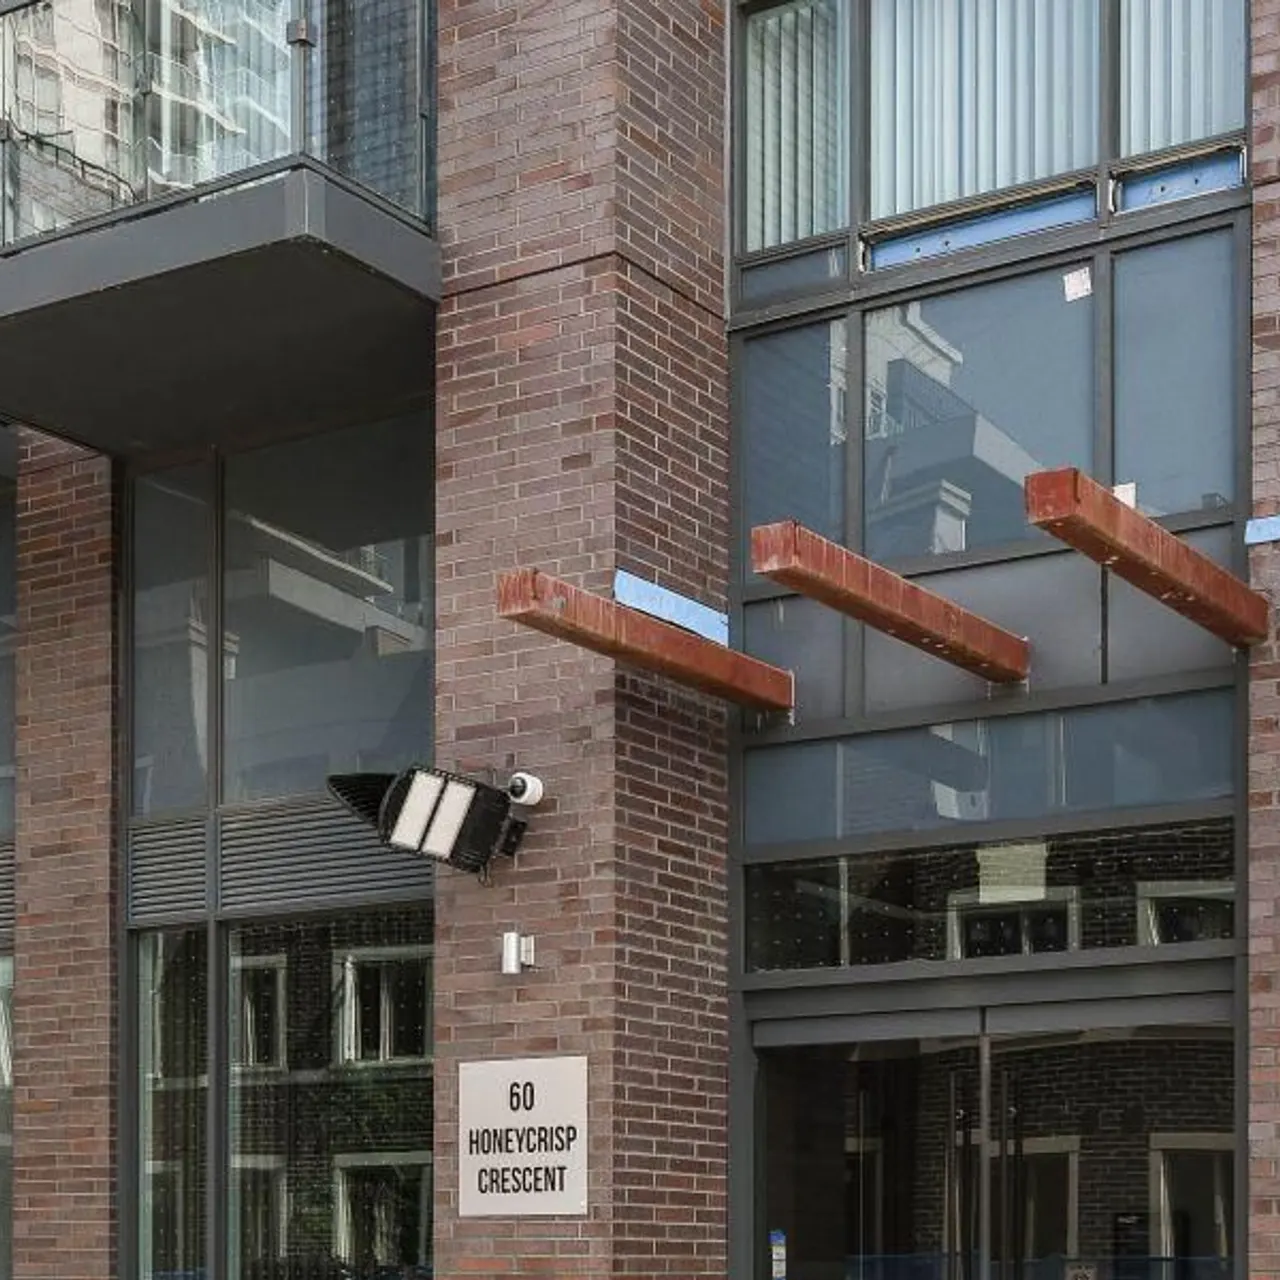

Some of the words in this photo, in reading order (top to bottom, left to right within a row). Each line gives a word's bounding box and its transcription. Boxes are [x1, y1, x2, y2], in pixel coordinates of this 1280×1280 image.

[509, 1082, 535, 1111] 60
[469, 1126, 577, 1155] HONEYCRISP
[477, 1166, 567, 1194] CRESCENT
